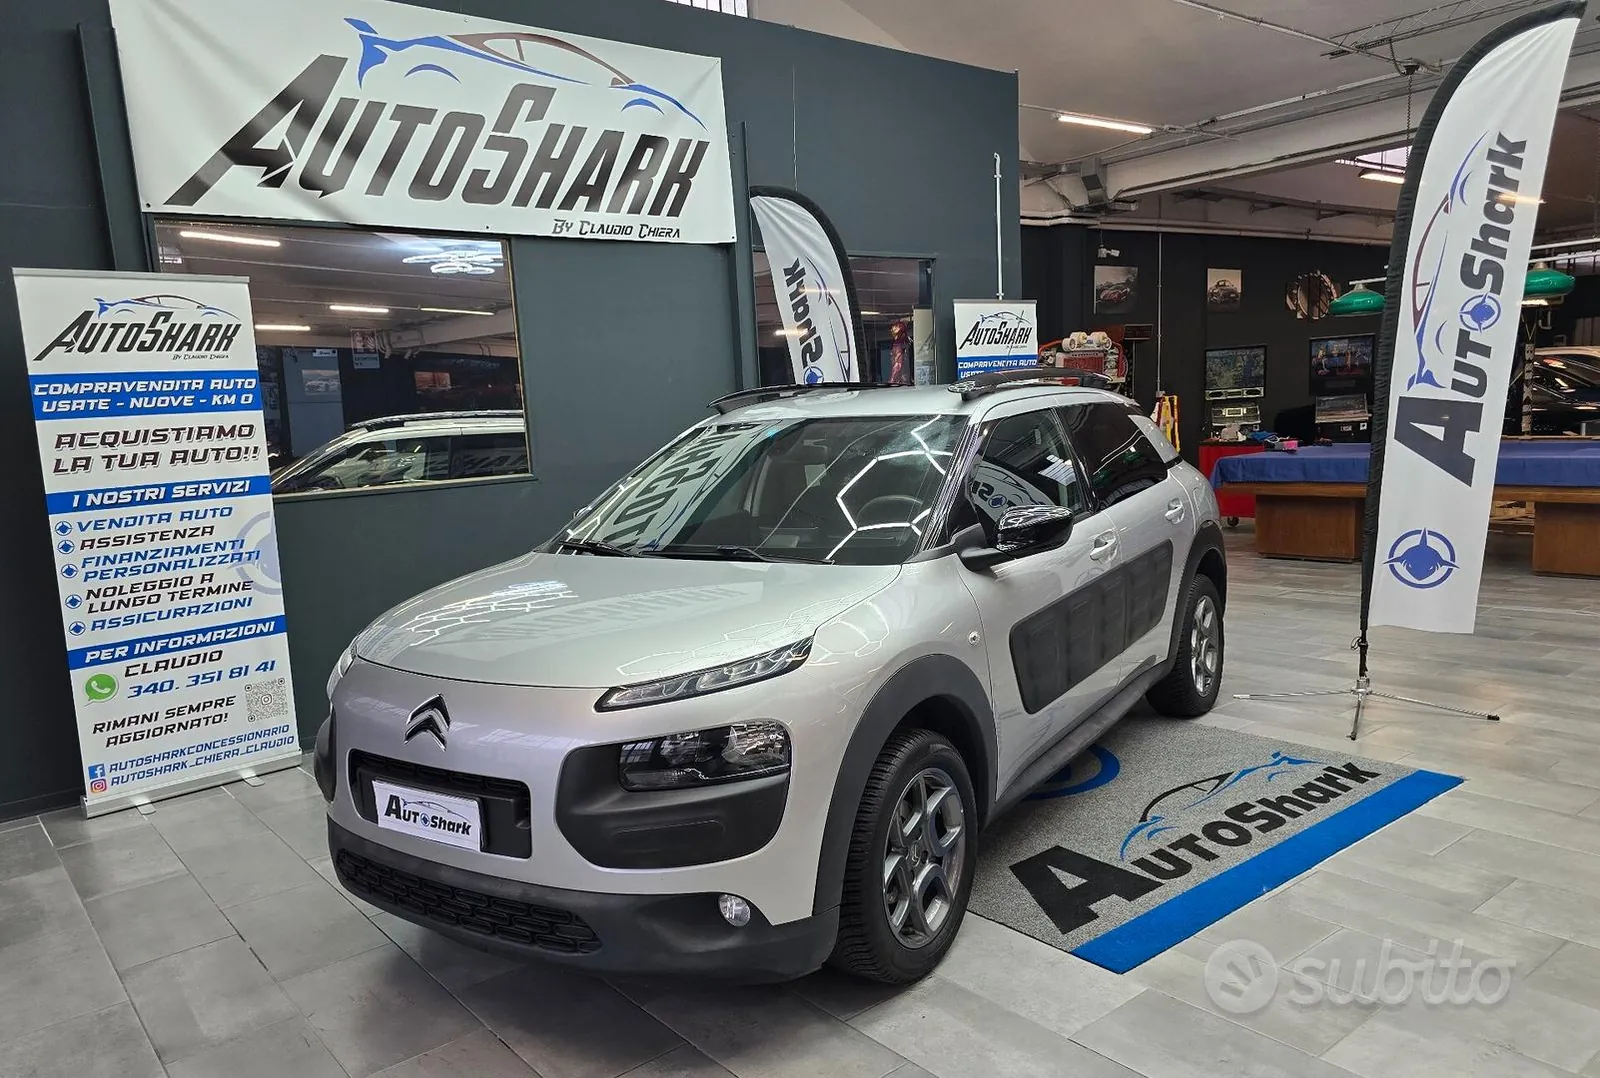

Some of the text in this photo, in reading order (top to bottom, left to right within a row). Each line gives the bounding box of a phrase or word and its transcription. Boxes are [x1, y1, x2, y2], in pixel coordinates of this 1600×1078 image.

[34, 378, 257, 396] COMPRAVENDITA AUTO
[42, 398, 111, 413] USATE
[130, 395, 194, 409] NUOVE
[212, 394, 237, 406] KM
[54, 424, 255, 450] ACQUISTIAMO
[52, 446, 261, 474] LA TUA AUTO!!
[73, 480, 251, 508] I NOSTRI SERVIZI
[77, 506, 234, 532] VENDITA AUTO
[80, 525, 215, 551] ASSISTENZA
[81, 538, 245, 569] FINANZIAMENTI
[83, 549, 261, 583] PERSONALIZZATI
[85, 572, 214, 600] NOLEGGIO A
[87, 580, 254, 614] LUNGO TERMINE
[90, 597, 253, 632] ASSICURAZIONI
[84, 621, 276, 664] PER INFORMAZIONI
[124, 649, 224, 678] CLAUDIO
[127, 659, 276, 699] 340. 351 81 41
[92, 695, 237, 735] RIMANI SEMPRE
[105, 712, 228, 748] AGGIORNATO!
[109, 724, 290, 773] AUTOSHARKCONCESSIONARIO
[110, 735, 295, 786] AUTOSHARK_CHIERA_CLAUDIO
